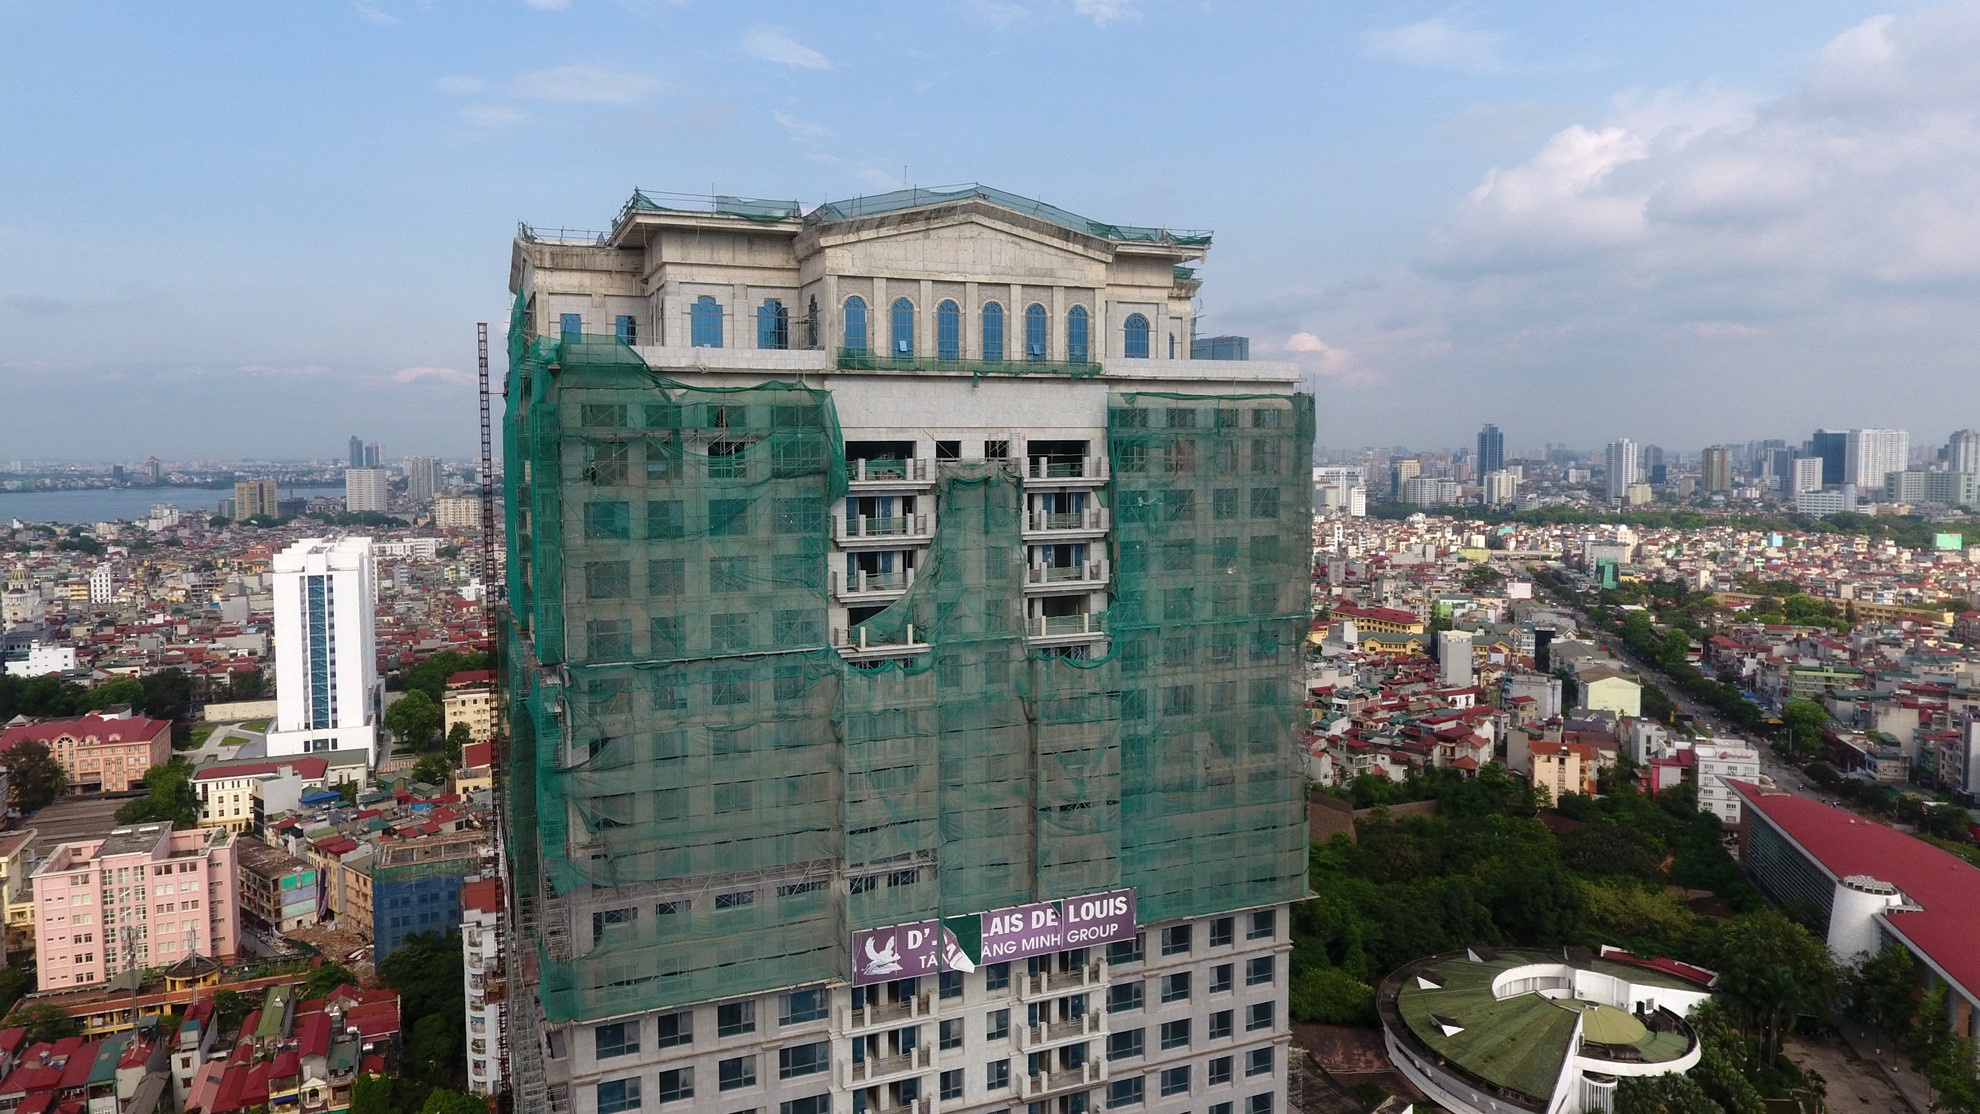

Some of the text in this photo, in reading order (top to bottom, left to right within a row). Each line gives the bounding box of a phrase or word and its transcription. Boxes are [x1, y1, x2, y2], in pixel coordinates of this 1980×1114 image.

[1031, 908, 1059, 929] DE
[1068, 896, 1128, 923] LOUIS
[1021, 933, 1061, 951] MINH
[1067, 923, 1119, 943] GROUP
